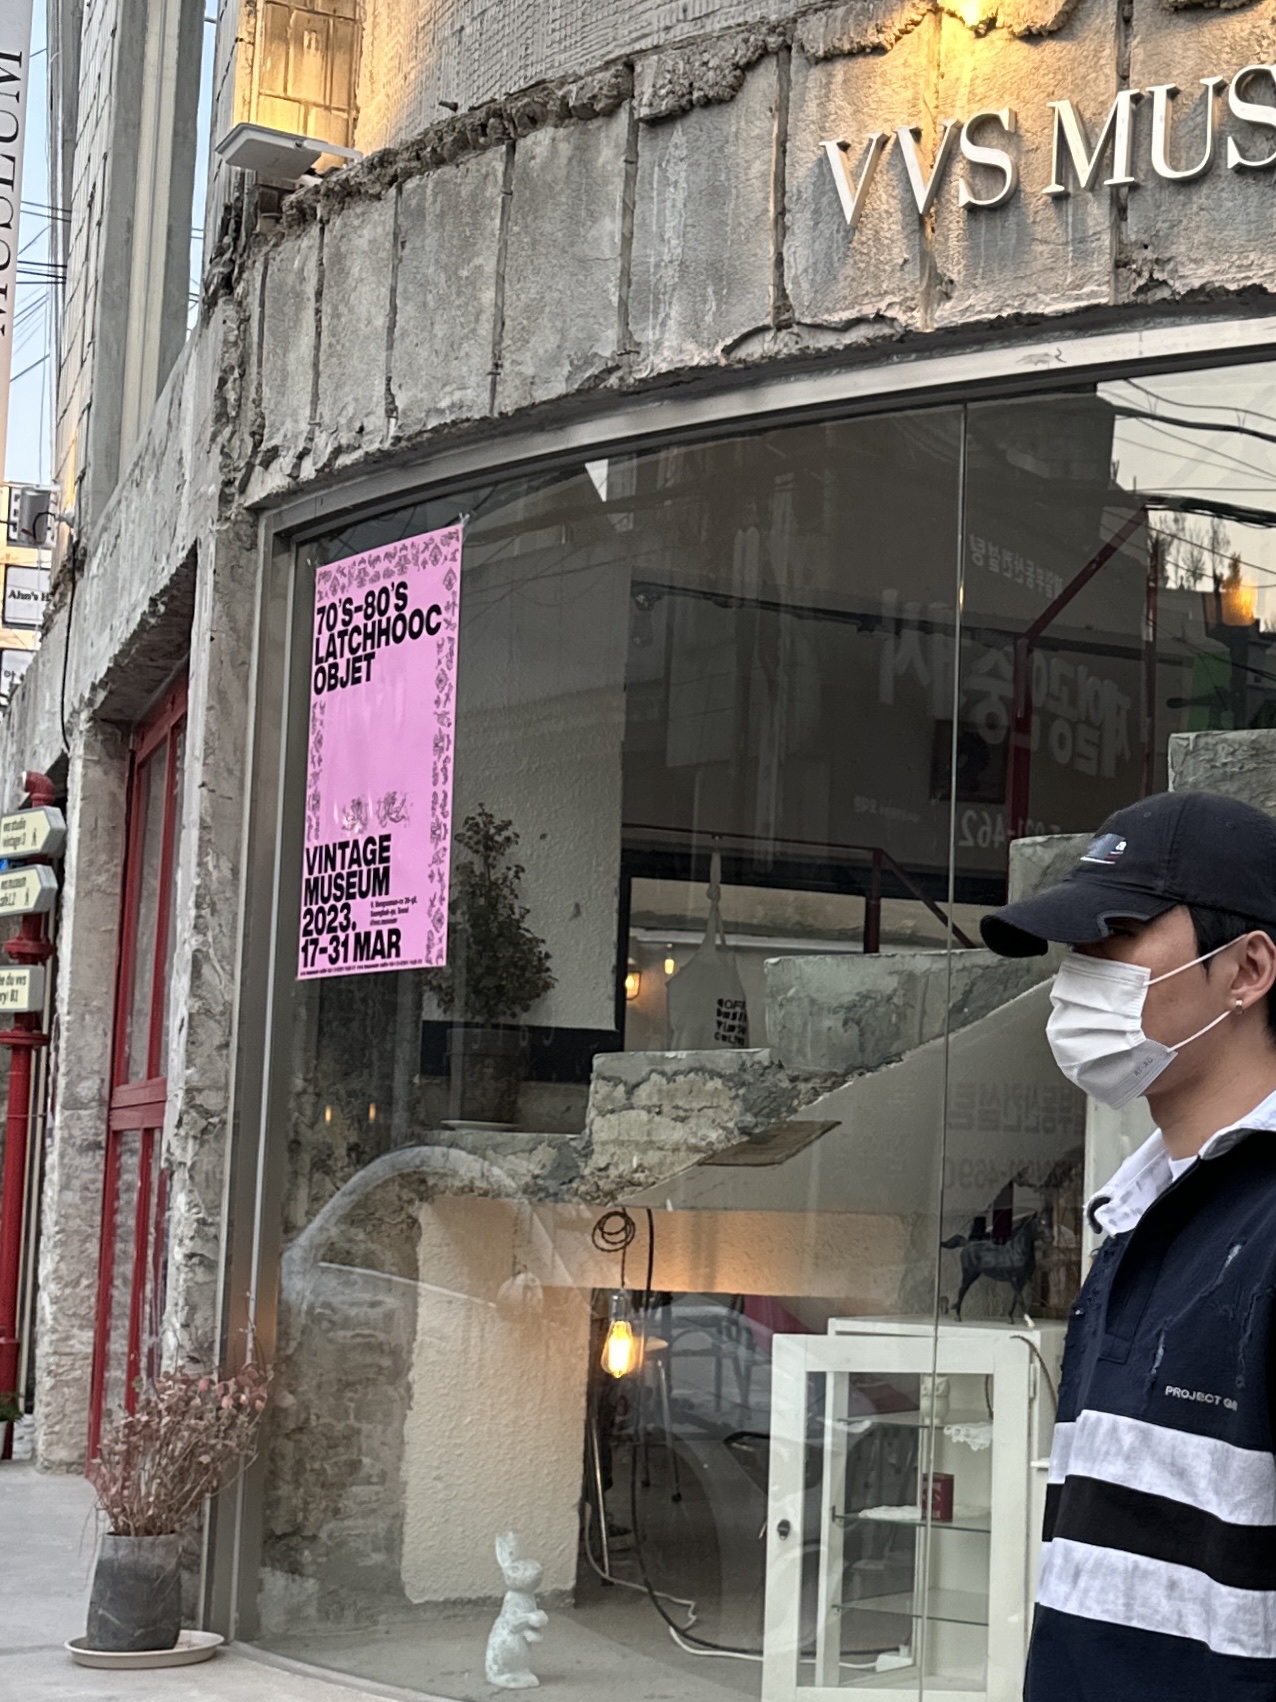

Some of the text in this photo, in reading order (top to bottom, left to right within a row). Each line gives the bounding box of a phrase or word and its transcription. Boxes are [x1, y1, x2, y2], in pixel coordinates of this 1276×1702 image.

[819, 107, 1018, 226] VVS
[317, 581, 408, 635] 70'S-80'S
[315, 604, 442, 666] LATCHHOOC
[314, 651, 375, 695] OBJET
[306, 834, 391, 876] VINTAGE
[304, 865, 390, 907] MUSEUM
[302, 902, 357, 937] 2023.
[301, 934, 349, 968] 17-31
[353, 928, 401, 962] MAR
[1165, 1385, 1222, 1405] PROJECT
